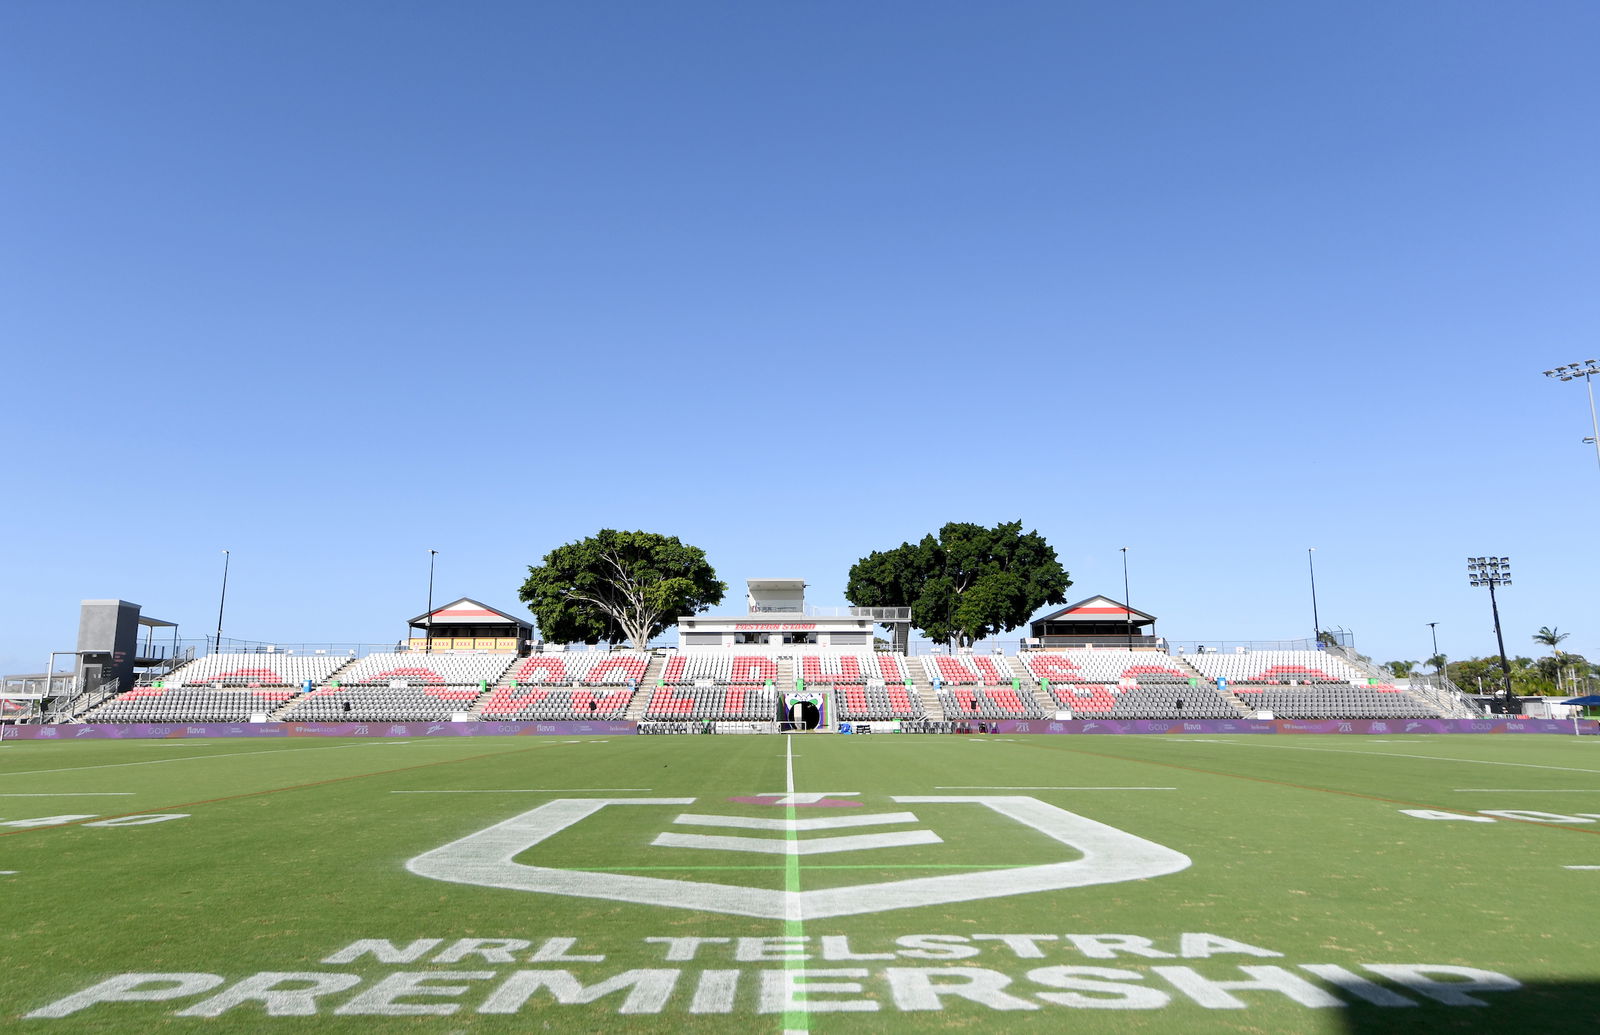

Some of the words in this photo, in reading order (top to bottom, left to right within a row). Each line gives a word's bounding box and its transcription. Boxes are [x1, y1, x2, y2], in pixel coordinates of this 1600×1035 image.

[187, 726, 206, 734] flava
[536, 724, 555, 732] flava
[320, 937, 606, 964] NRL
[645, 932, 1285, 960] TELSTRA
[23, 963, 1523, 1019] PREMIERSHIP
